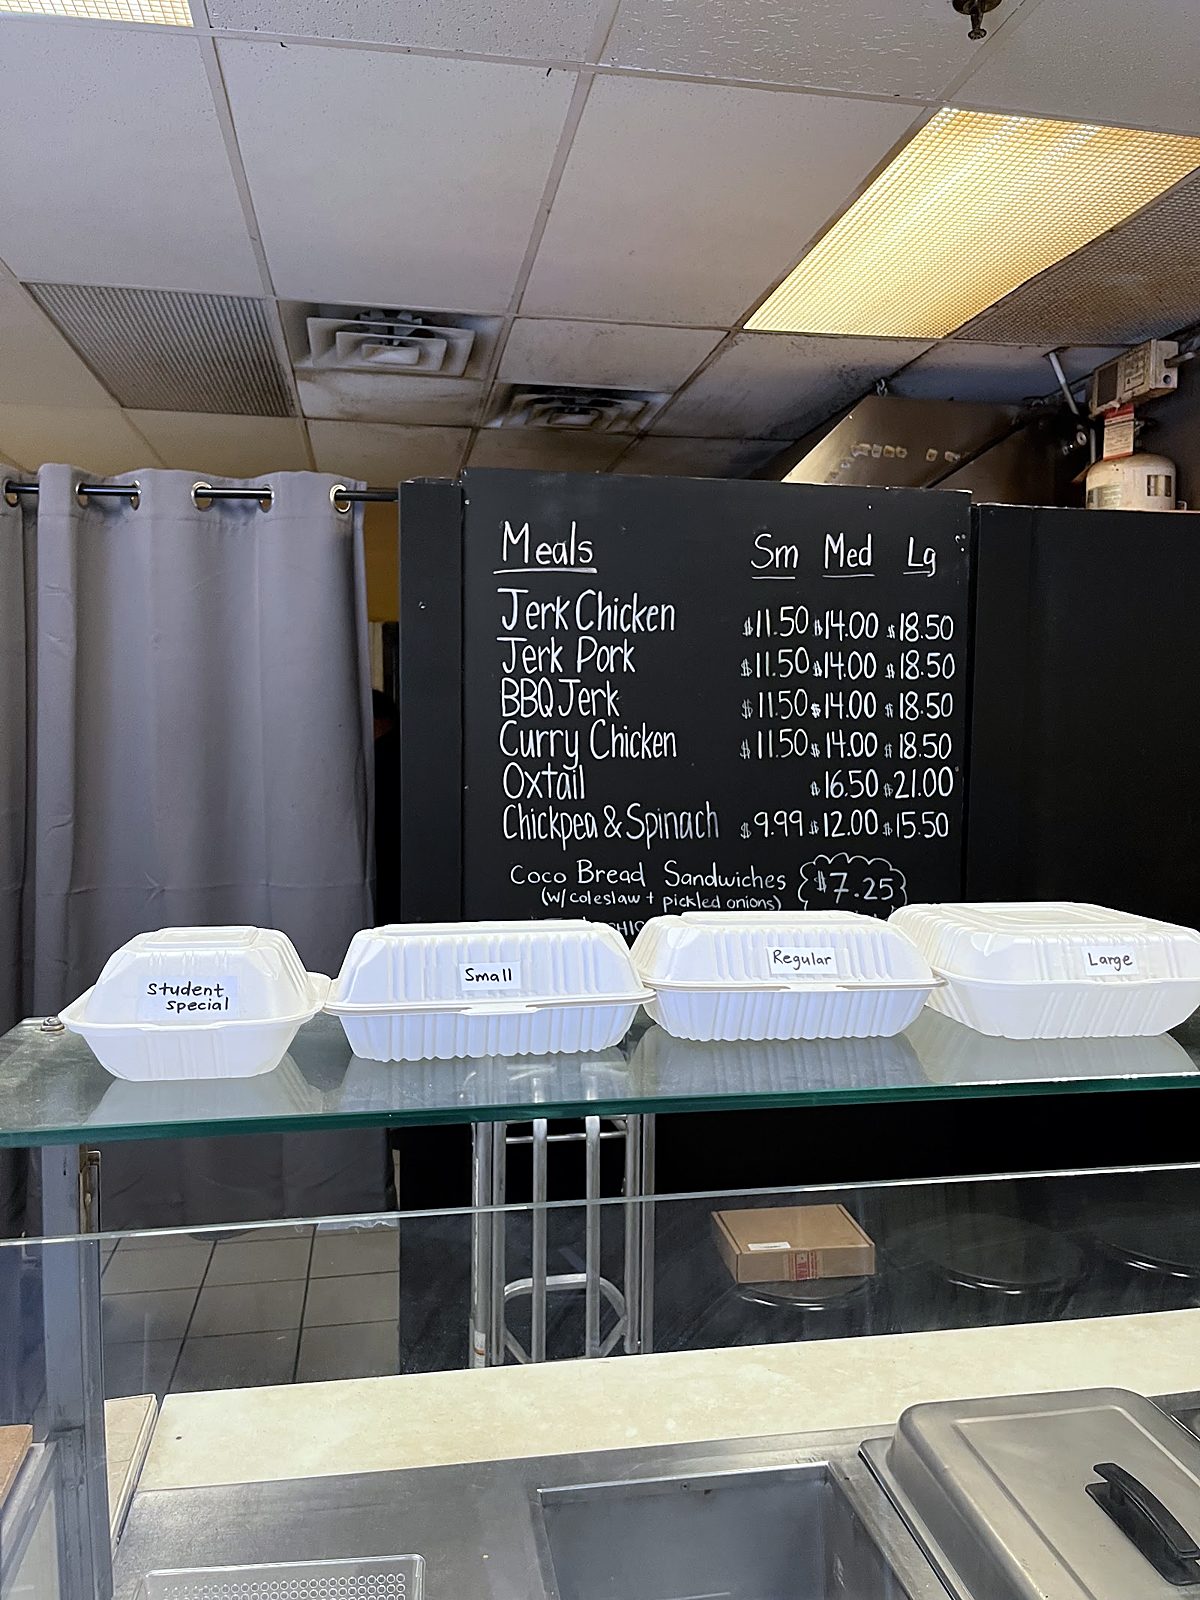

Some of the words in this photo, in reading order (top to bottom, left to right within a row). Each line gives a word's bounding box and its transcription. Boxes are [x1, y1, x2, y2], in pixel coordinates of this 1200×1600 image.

[501, 521, 592, 565] Meals
[751, 534, 798, 568] Sm
[825, 533, 871, 569] Med
[908, 537, 936, 577] Lg
[497, 588, 570, 630] Jerk
[576, 589, 674, 633] Chicken
[743, 606, 808, 637] $11.50
[815, 610, 878, 641] $14.00
[887, 612, 953, 642] $18.50
[497, 637, 562, 674] Jerk
[577, 636, 635, 673] Pork
[741, 647, 809, 678] $11.50
[813, 651, 876, 680] $14.00
[885, 650, 955, 679] $18.50
[502, 677, 553, 718] BBQ
[558, 679, 619, 716] Jerk
[742, 689, 807, 719] $11.50
[811, 690, 876, 719] $14.00
[885, 691, 953, 720] $18.50
[500, 720, 579, 770] Curry
[590, 719, 676, 759] Chicken
[740, 729, 808, 759] $11.50
[811, 730, 877, 758] $14.00
[885, 732, 951, 759] $18.50
[503, 760, 584, 800] Oxtail
[811, 769, 878, 798] $16.50
[884, 766, 953, 799] $21.00
[504, 803, 598, 850] Chickpea
[604, 805, 622, 838] &
[626, 801, 718, 849] Spinach
[741, 810, 802, 839] $9.99
[809, 809, 878, 837] $12.00
[883, 812, 948, 838] $15.50
[511, 865, 566, 884] Coco
[577, 859, 645, 887] Bread
[665, 860, 786, 890] Sandwiches
[814, 870, 894, 903] $7.25
[646, 891, 655, 905] +
[663, 892, 722, 913] pickled
[727, 895, 781, 911] onions)
[466, 968, 511, 982] Small
[774, 950, 831, 970] Regular
[1089, 954, 1132, 971] Large
[147, 981, 224, 997] Student
[166, 996, 228, 1013] special
